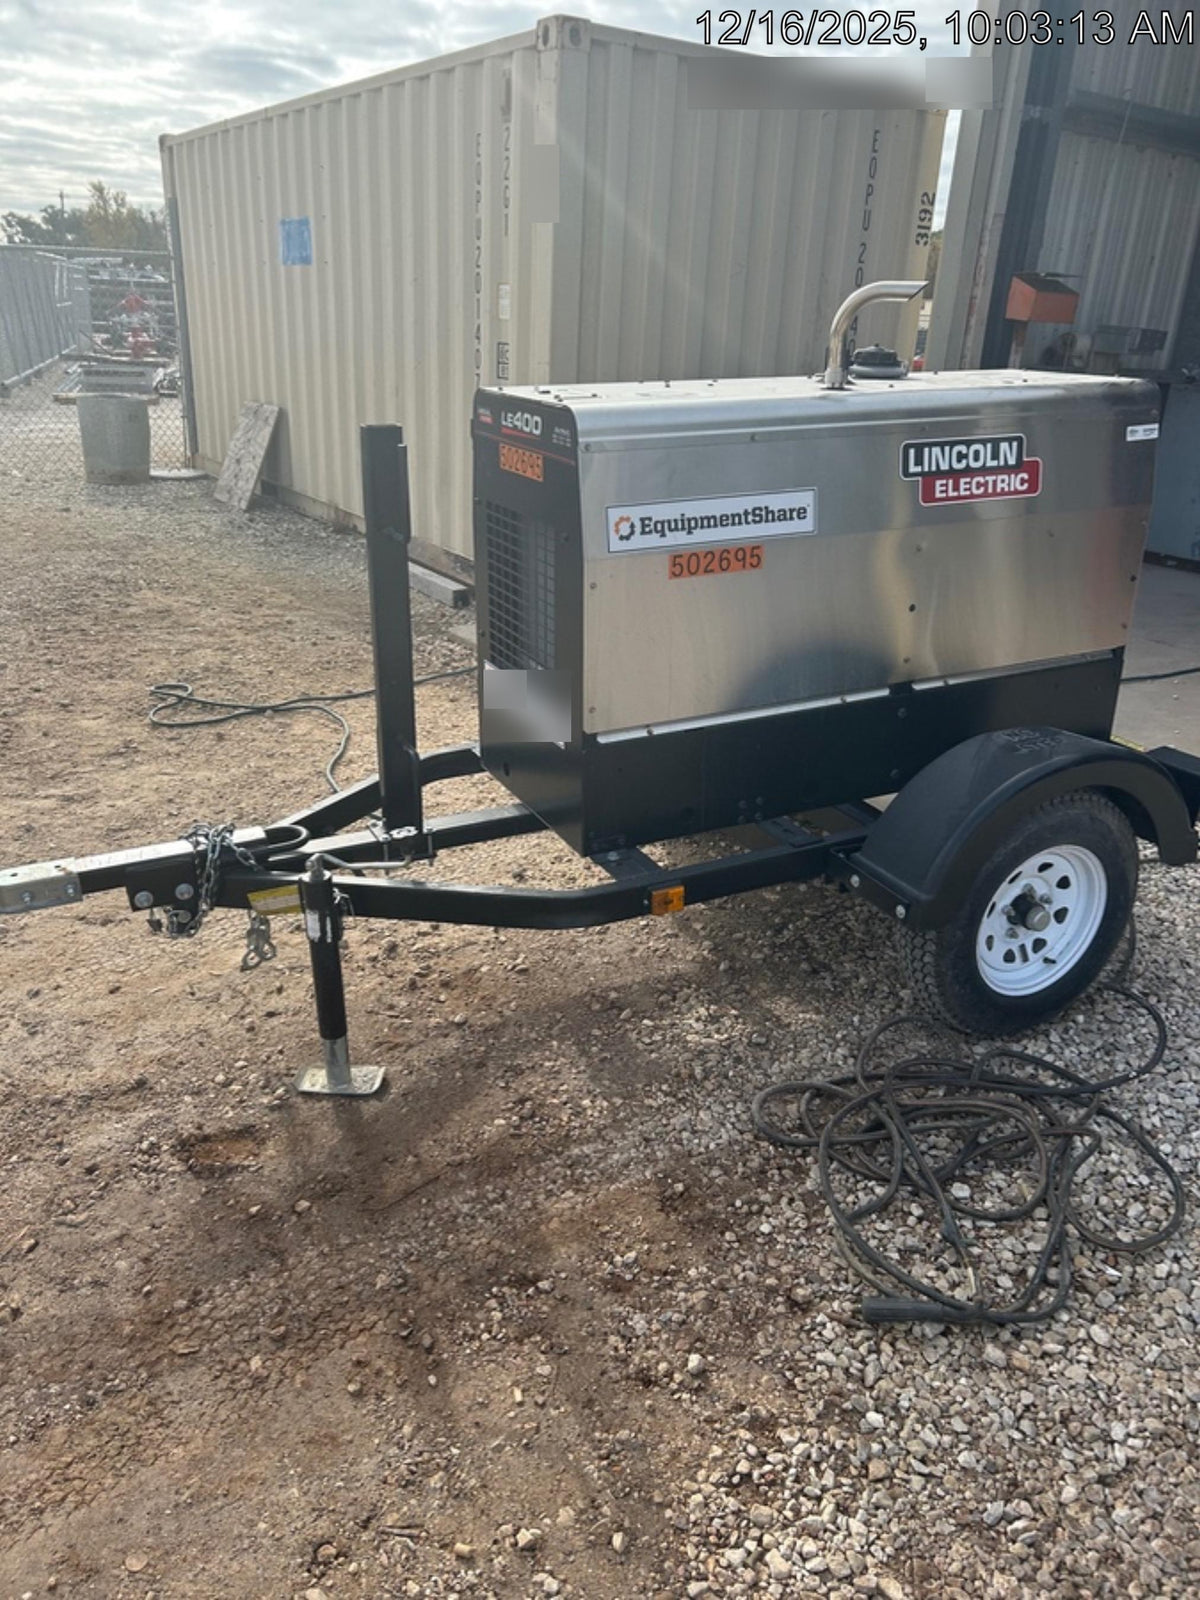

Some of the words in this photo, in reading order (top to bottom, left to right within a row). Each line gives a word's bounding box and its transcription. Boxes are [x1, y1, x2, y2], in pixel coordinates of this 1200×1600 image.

[914, 191, 936, 247] 3192
[501, 444, 542, 479] 502695
[908, 441, 1018, 473] LINCOLN
[934, 472, 1029, 499] ELECTRIC
[639, 505, 808, 537] EquipmentShare
[671, 545, 762, 577] 502695
